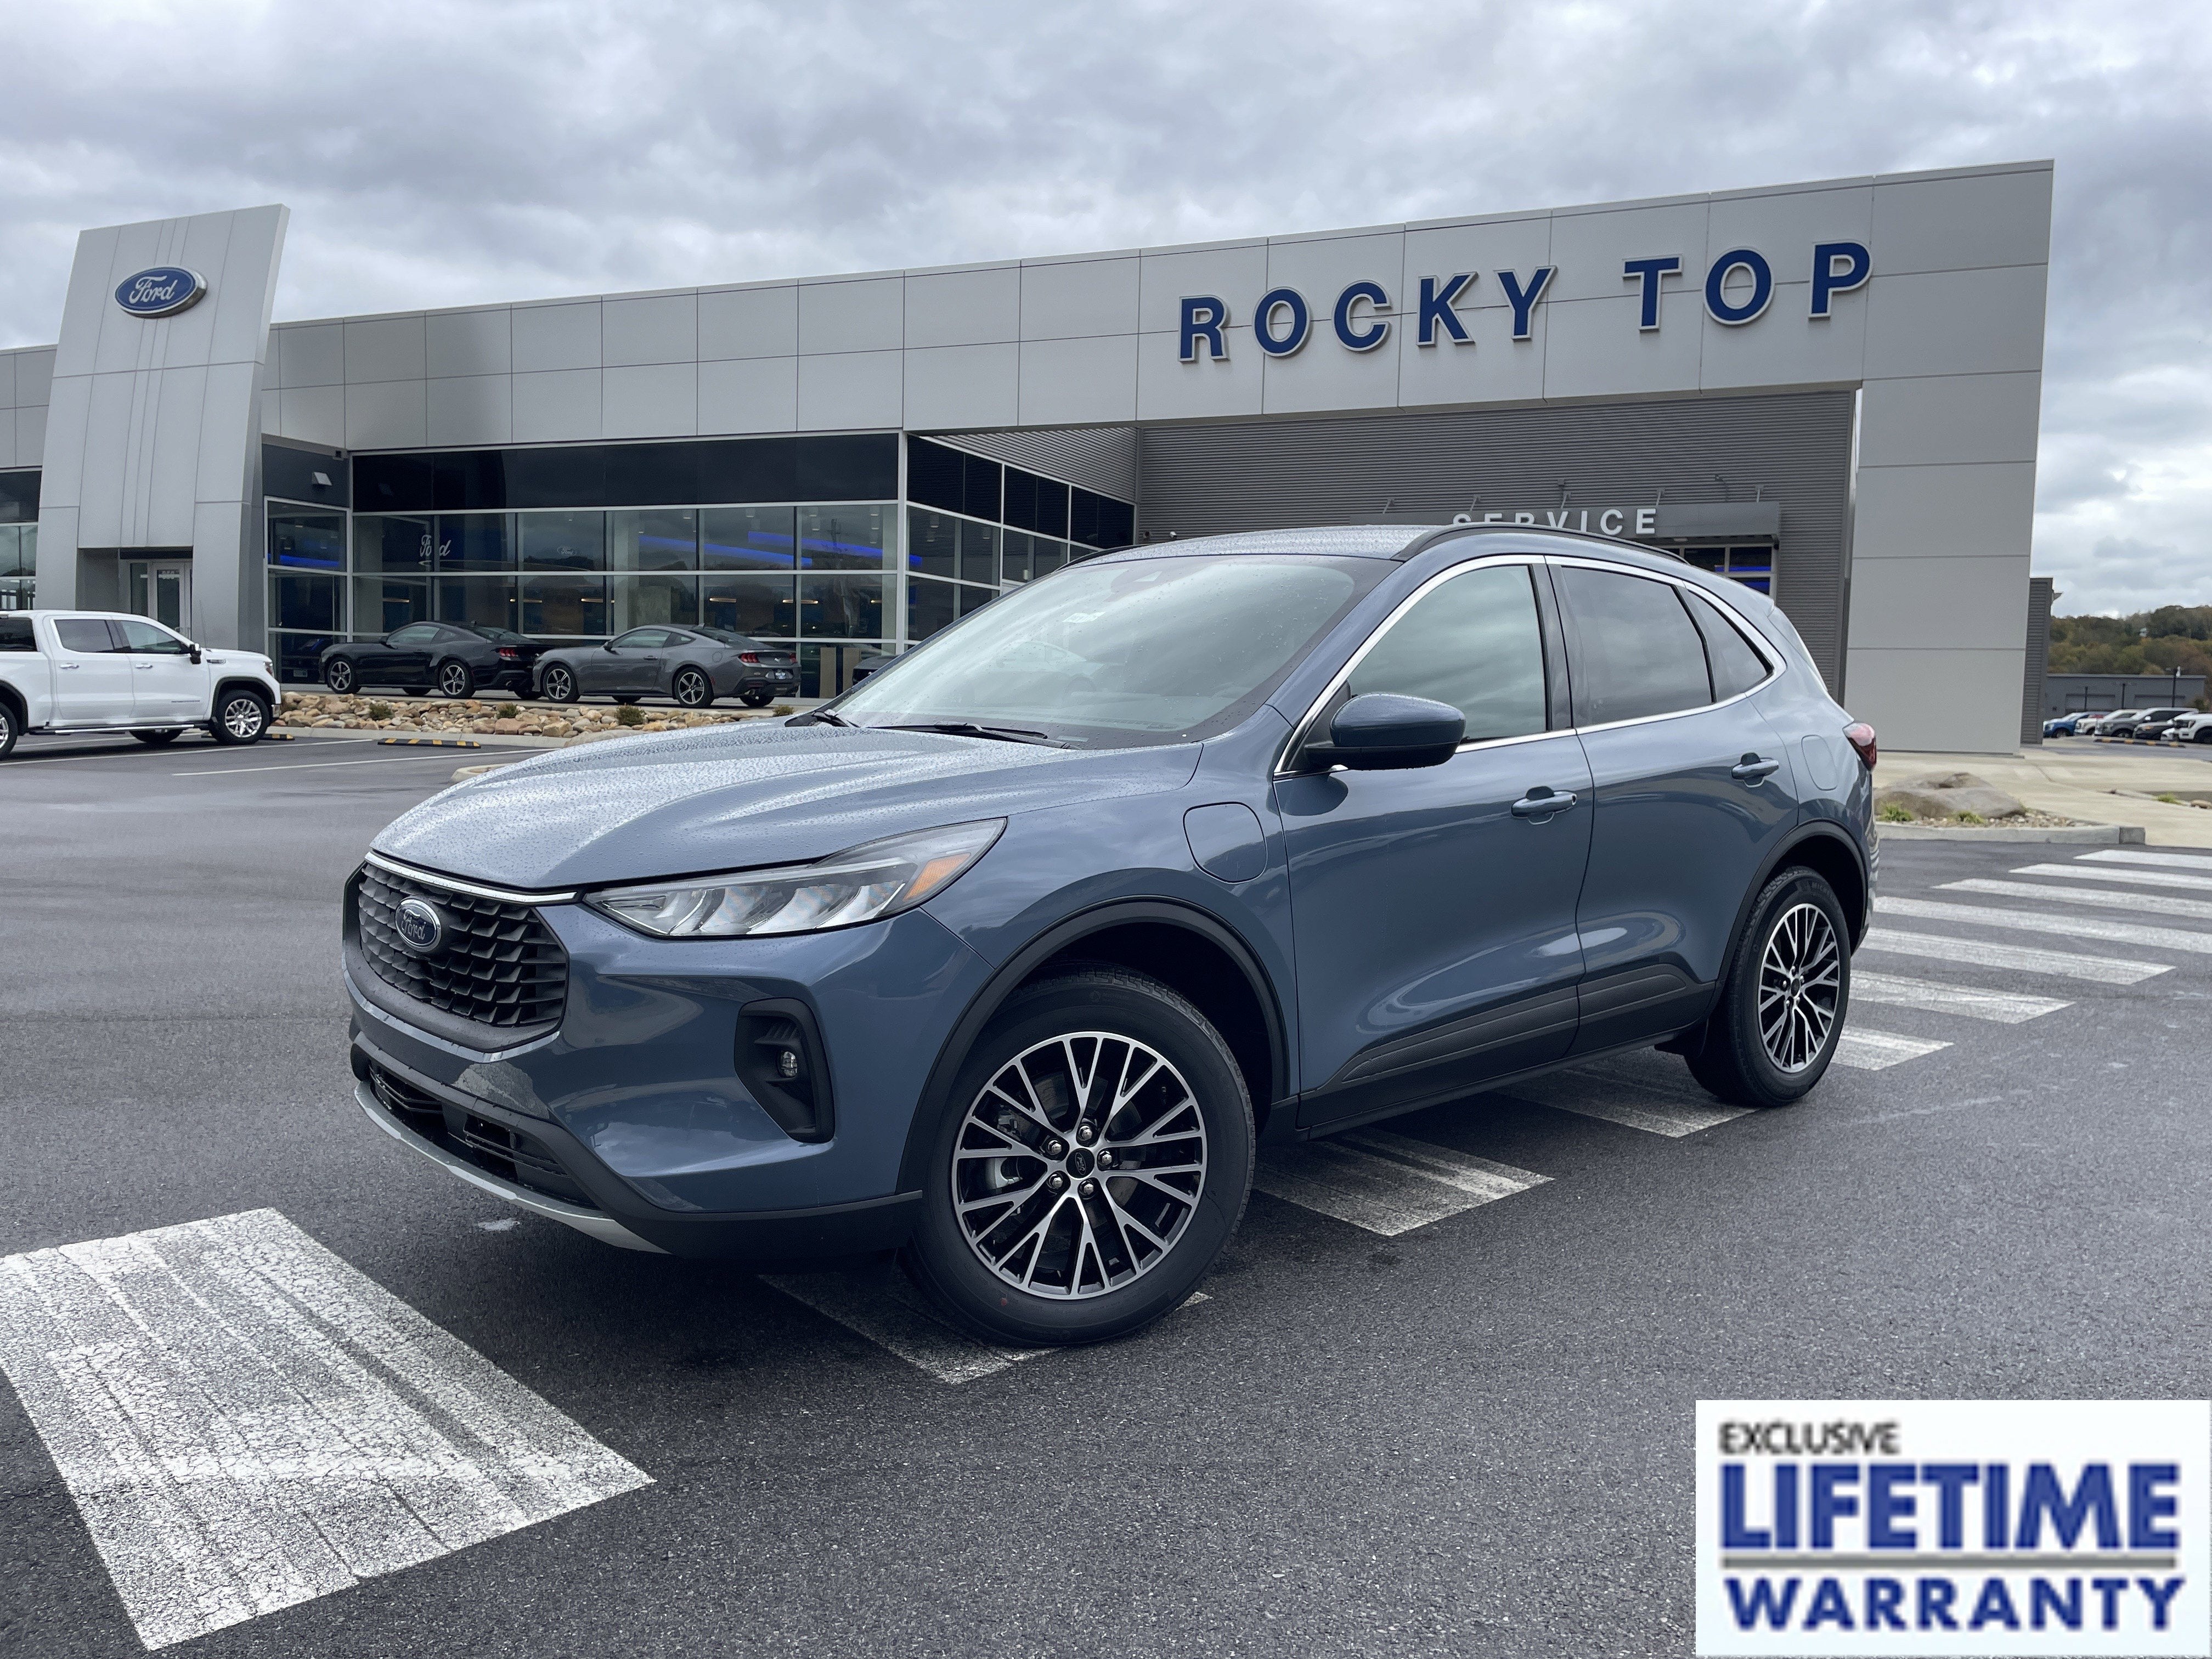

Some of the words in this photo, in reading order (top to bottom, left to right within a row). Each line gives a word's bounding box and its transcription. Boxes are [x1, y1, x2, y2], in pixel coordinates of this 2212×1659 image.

[128, 275, 179, 304] Ford
[1178, 265, 1558, 362] ROCKY
[1622, 239, 1872, 331] TOP
[420, 534, 452, 557] Fod
[400, 909, 426, 941] Ford
